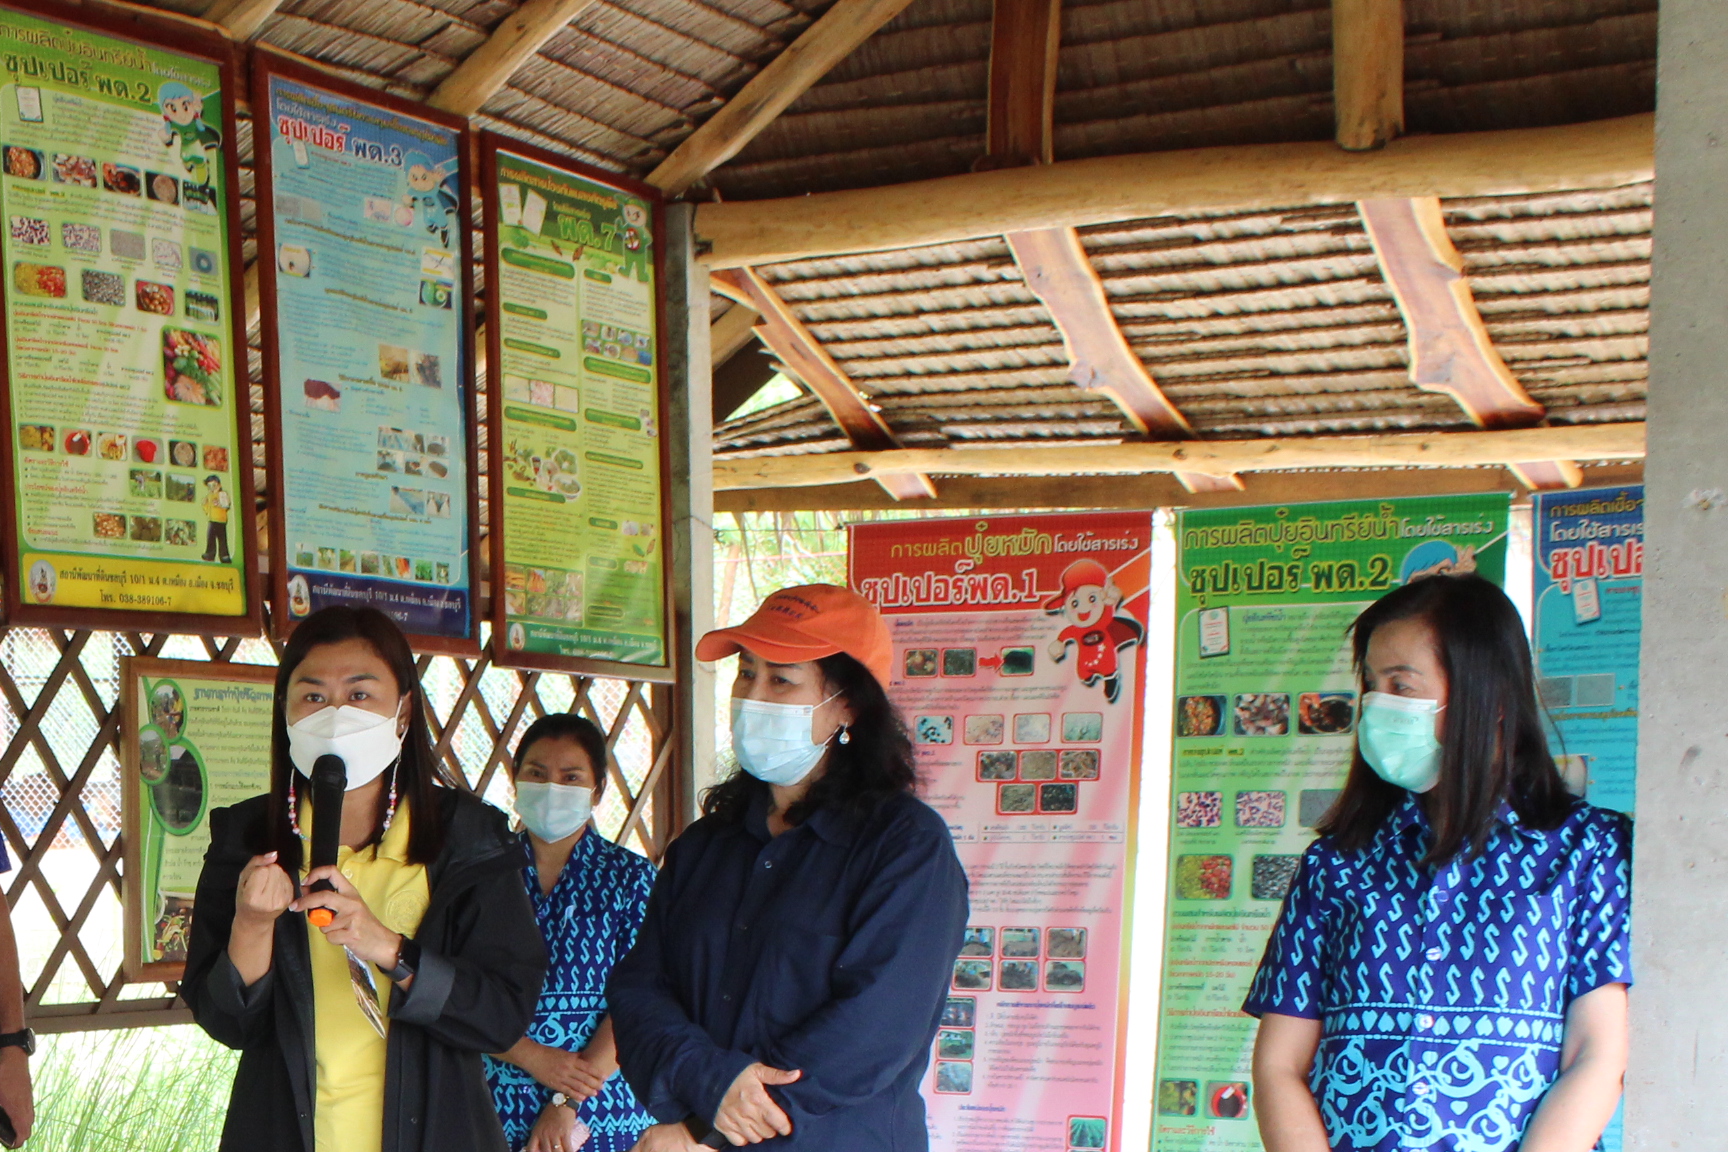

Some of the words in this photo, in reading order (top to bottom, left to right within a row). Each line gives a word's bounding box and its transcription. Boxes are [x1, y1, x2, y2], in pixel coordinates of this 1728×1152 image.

[95, 74, 152, 103] พด.2
[352, 137, 403, 166] พด.3
[861, 559, 1039, 607] ซปเปอร์พด.1
[1310, 554, 1393, 593] พด.2
